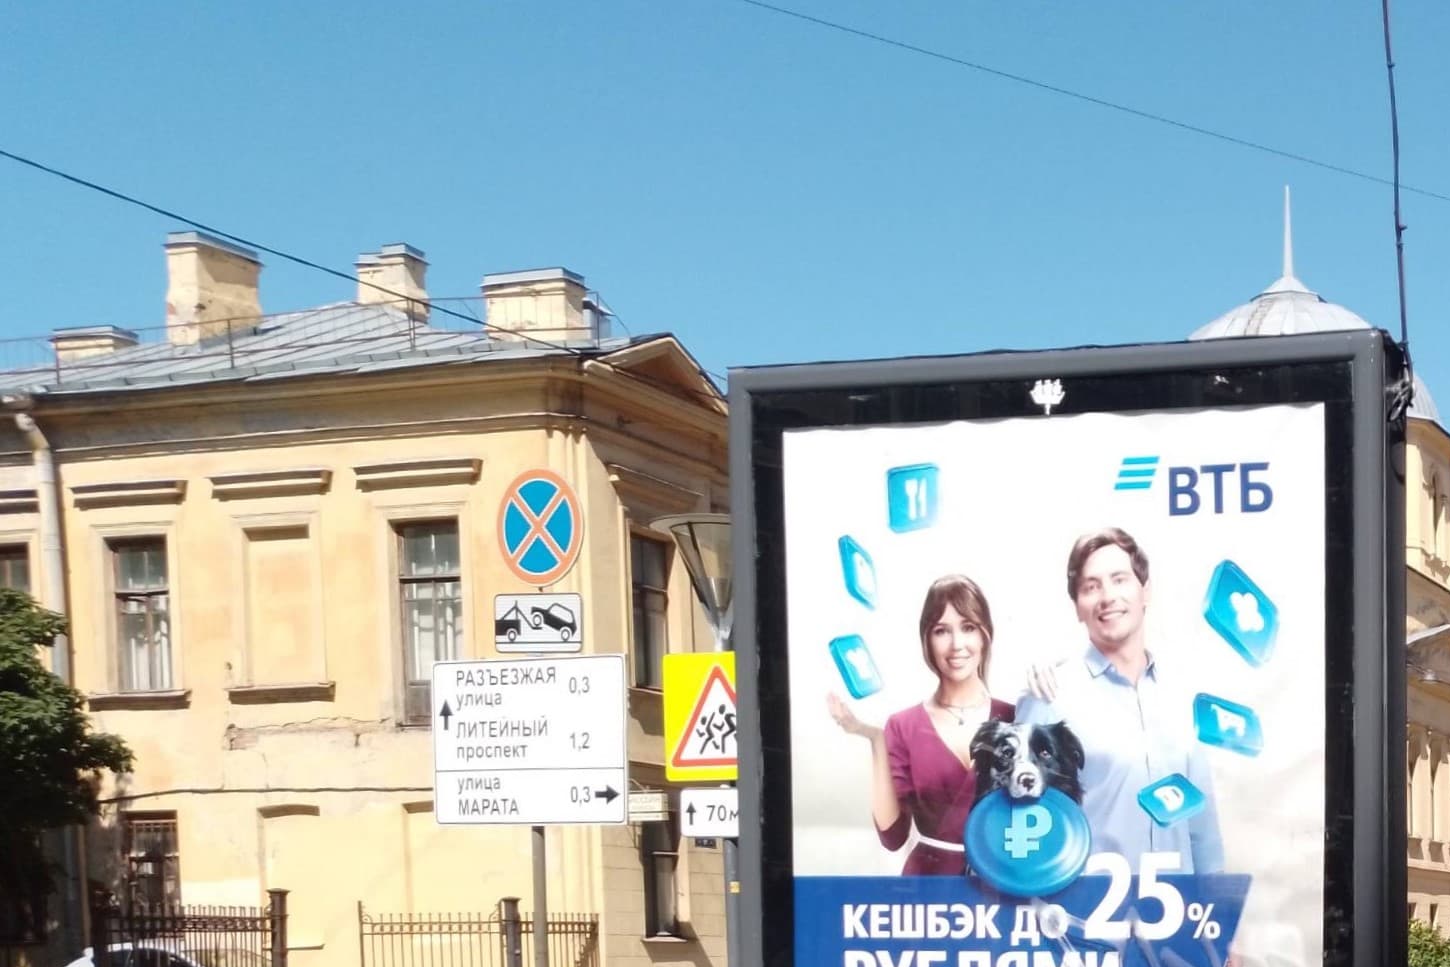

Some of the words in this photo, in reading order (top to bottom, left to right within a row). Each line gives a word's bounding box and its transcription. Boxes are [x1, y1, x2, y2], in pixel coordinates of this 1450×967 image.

[1168, 462, 1273, 516] ВТБ
[456, 667, 557, 687] РАЗЪЕЗЖАЯ
[569, 676, 590, 695] 0,3
[456, 692, 502, 711] улица
[456, 714, 548, 738] ЛИТЕЙНЫЙ
[569, 732, 590, 751] 1,2
[457, 745, 528, 762] проспект
[458, 777, 501, 794] улица
[570, 786, 591, 805] 0,3
[458, 799, 520, 815] МАРАТА
[843, 904, 1002, 939] КЕШБЭК
[1010, 904, 1069, 946] ДО
